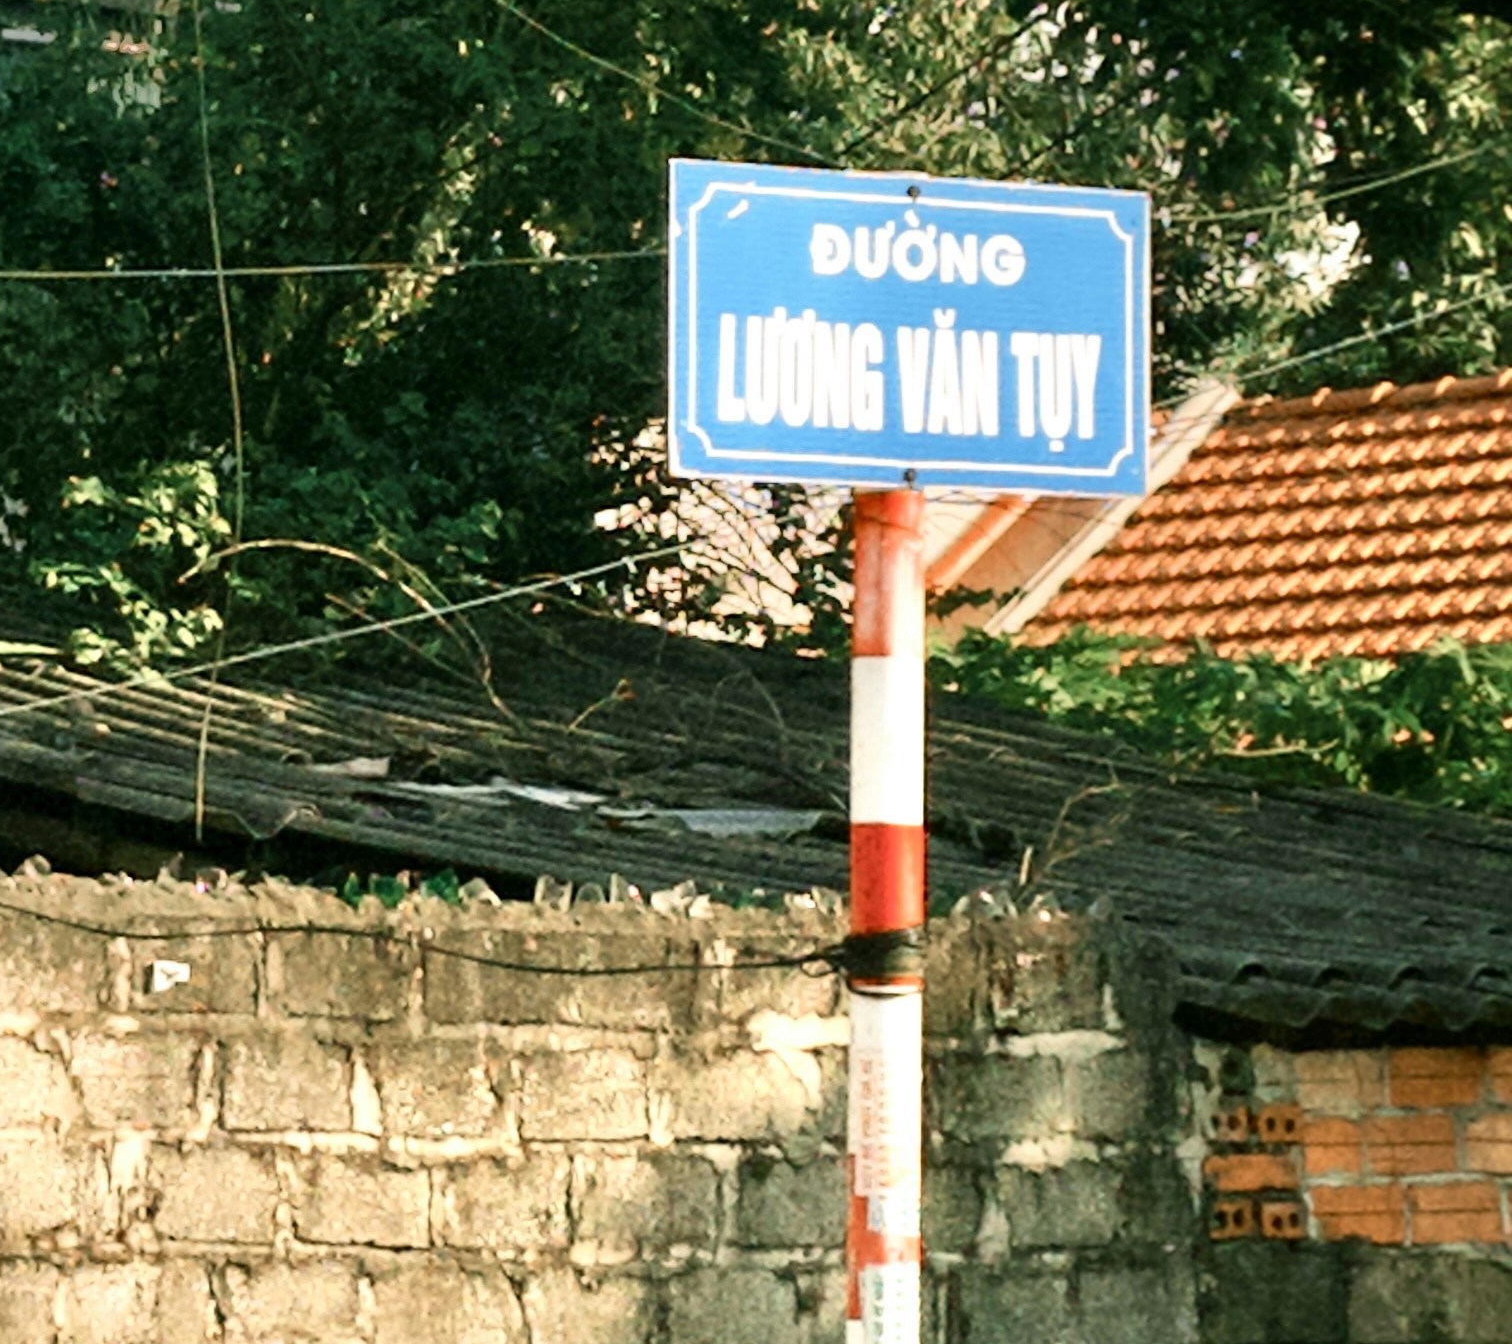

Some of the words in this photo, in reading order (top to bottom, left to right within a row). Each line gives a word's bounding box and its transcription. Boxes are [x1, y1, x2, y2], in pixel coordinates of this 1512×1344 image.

[809, 209, 1026, 286] ĐƯỜNG
[717, 306, 884, 432] LƯƠNG
[896, 308, 999, 437] VĂN
